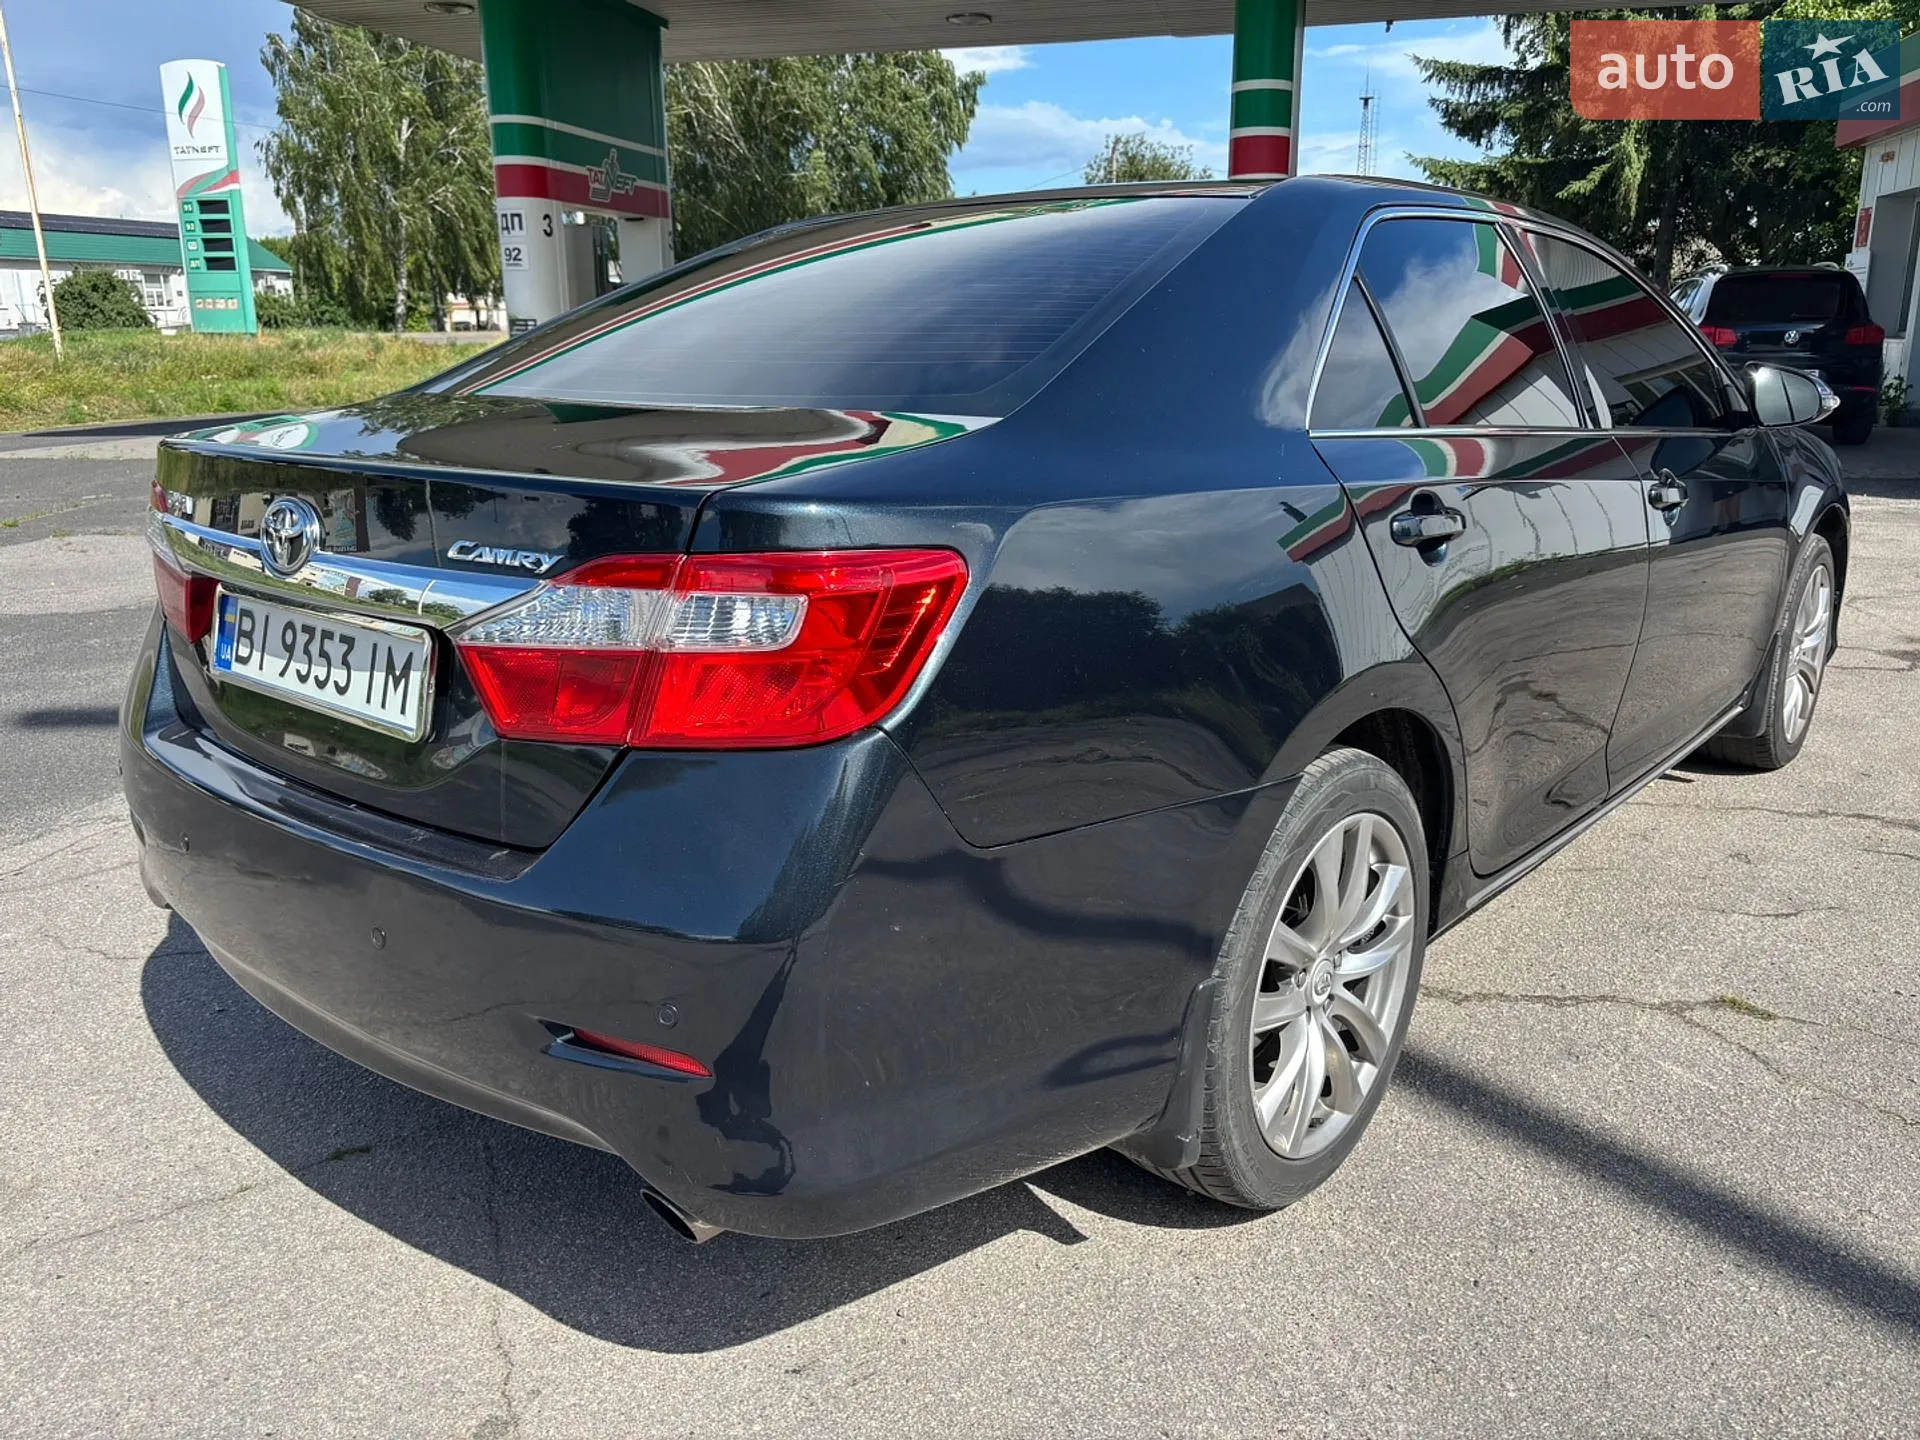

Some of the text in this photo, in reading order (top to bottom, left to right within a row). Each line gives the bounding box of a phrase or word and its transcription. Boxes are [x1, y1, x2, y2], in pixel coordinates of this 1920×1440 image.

[542, 213, 553, 238] 3
[503, 247, 522, 262] 92
[447, 540, 566, 575] CAMRY
[221, 643, 231, 660] UA
[234, 607, 413, 716] BI 9353 IM
